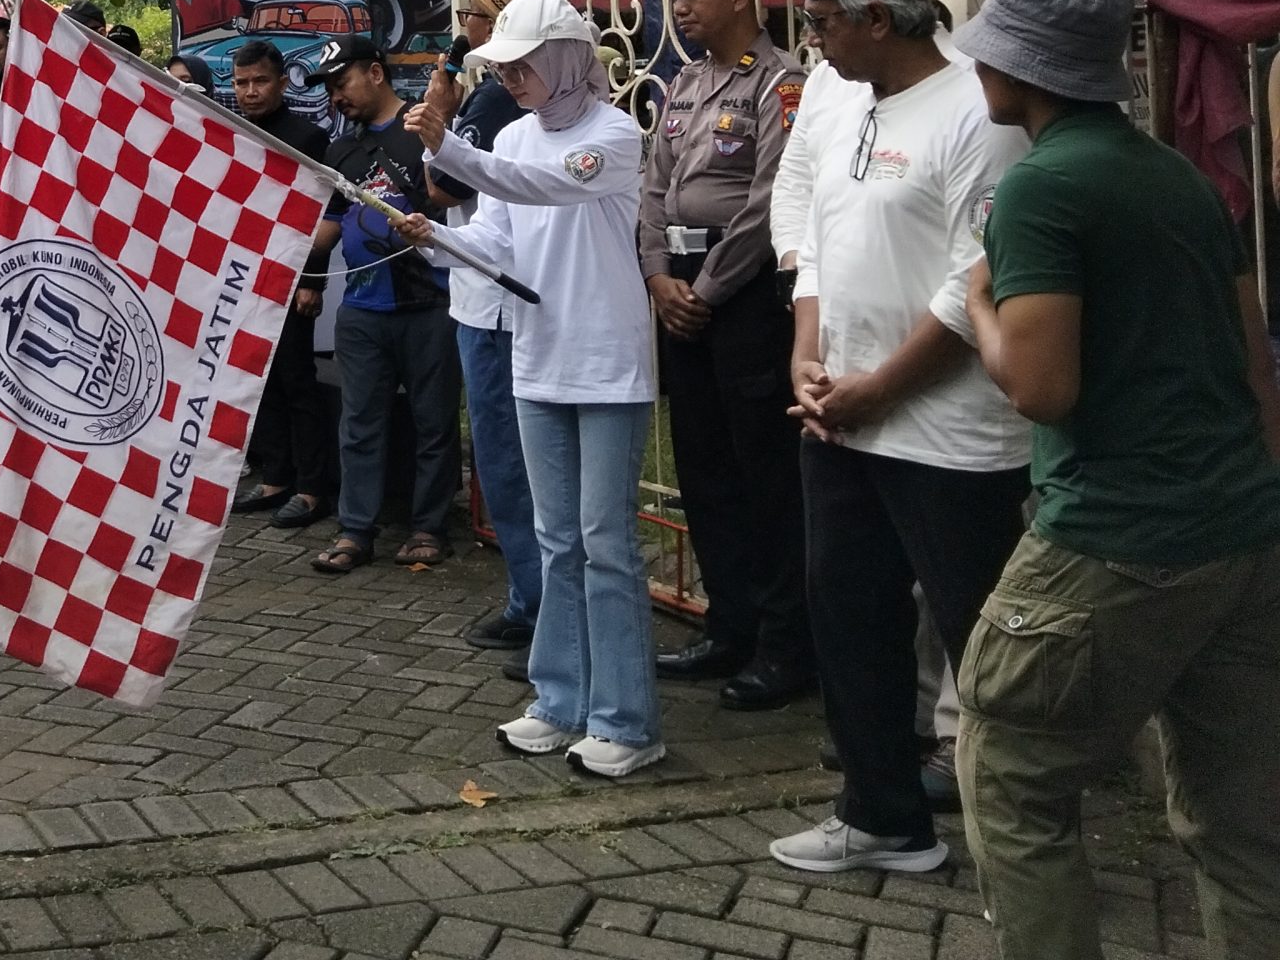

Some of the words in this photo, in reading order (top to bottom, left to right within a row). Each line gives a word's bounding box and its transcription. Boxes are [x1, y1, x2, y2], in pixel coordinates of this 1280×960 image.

[32, 251, 63, 266] KUNO
[69, 256, 117, 297] INDONESIA
[85, 324, 121, 402] PPMKI
[116, 358, 130, 390] 1979
[135, 395, 210, 572] PENGDA
[197, 259, 251, 382] JATIM
